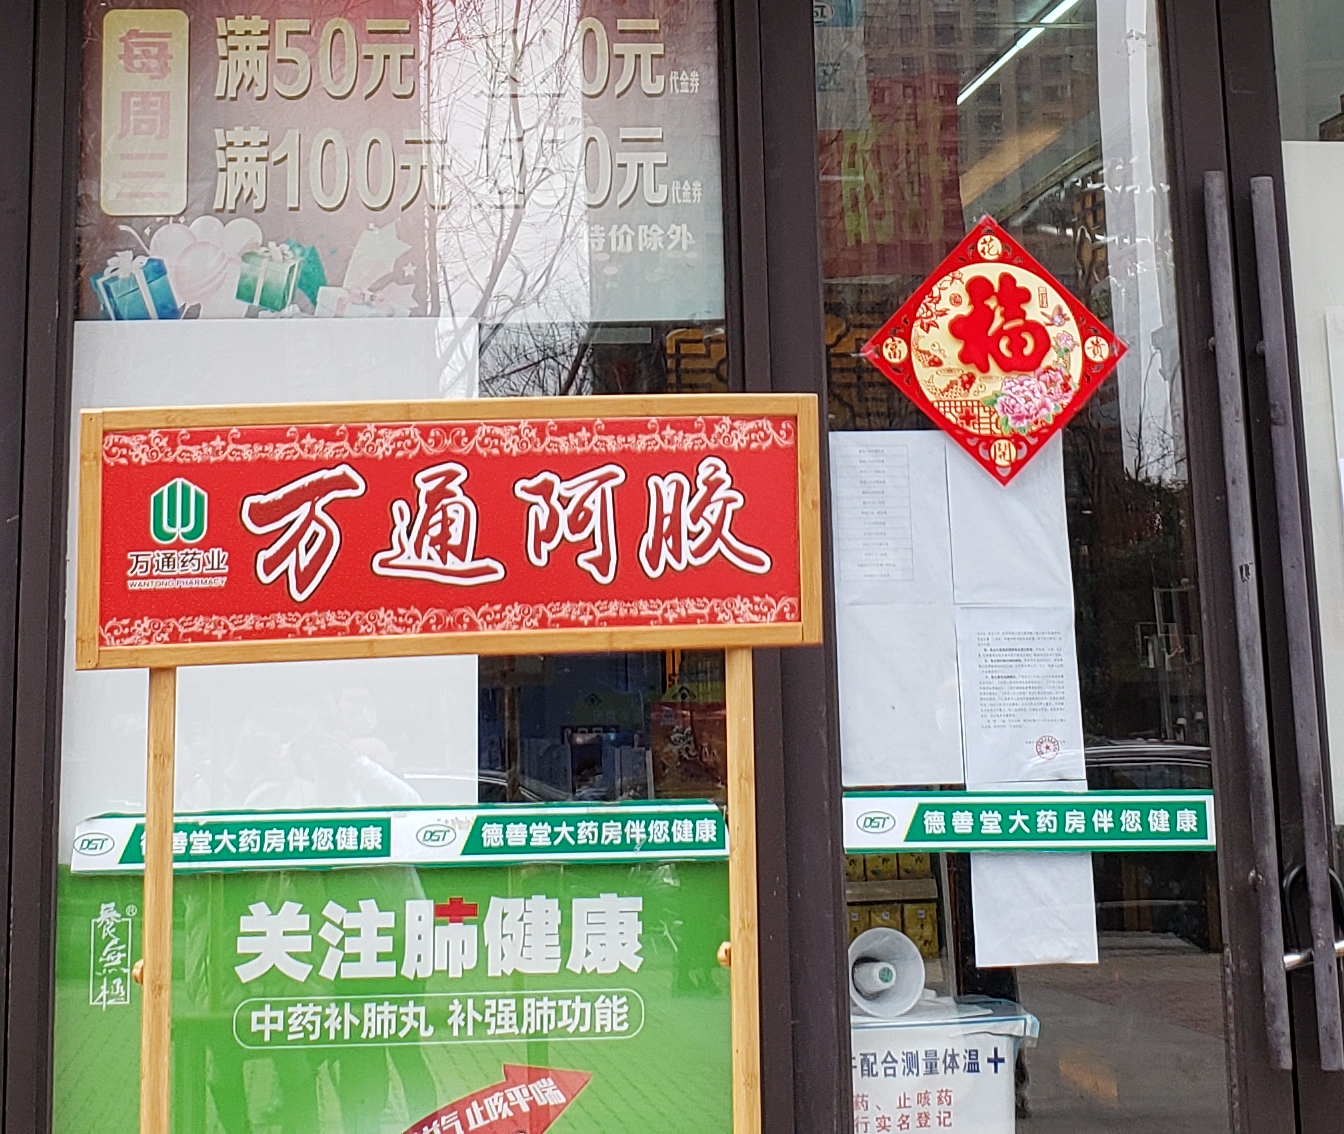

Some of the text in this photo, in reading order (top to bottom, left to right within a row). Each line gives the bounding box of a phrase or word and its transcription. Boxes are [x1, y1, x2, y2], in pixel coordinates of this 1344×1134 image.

[214, 16, 416, 100] 满50元
[669, 69, 700, 95] 代金券
[117, 28, 173, 200] 每周三
[214, 126, 452, 211] 满100元
[671, 180, 702, 205] 代金券
[948, 272, 1052, 373] 福
[241, 456, 774, 603] 万通阿胶
[127, 547, 229, 576] 万通药业
[127, 577, 226, 589] WANTONG PHARMACY
[422, 828, 451, 842] DST
[480, 817, 719, 850] 德善堂大药房伴您健康
[862, 816, 890, 829] DST
[923, 808, 1199, 835] 德善堂大药房伴您健康
[79, 837, 109, 851] DST
[140, 824, 384, 856] 善堂大药房伴您健康
[234, 894, 645, 984] 关注肺健康
[250, 991, 631, 1041] 中药补肺丸 补强肺功能
[852, 1047, 981, 1079] 配合测量体温
[465, 1077, 567, 1131] 止咳平喘
